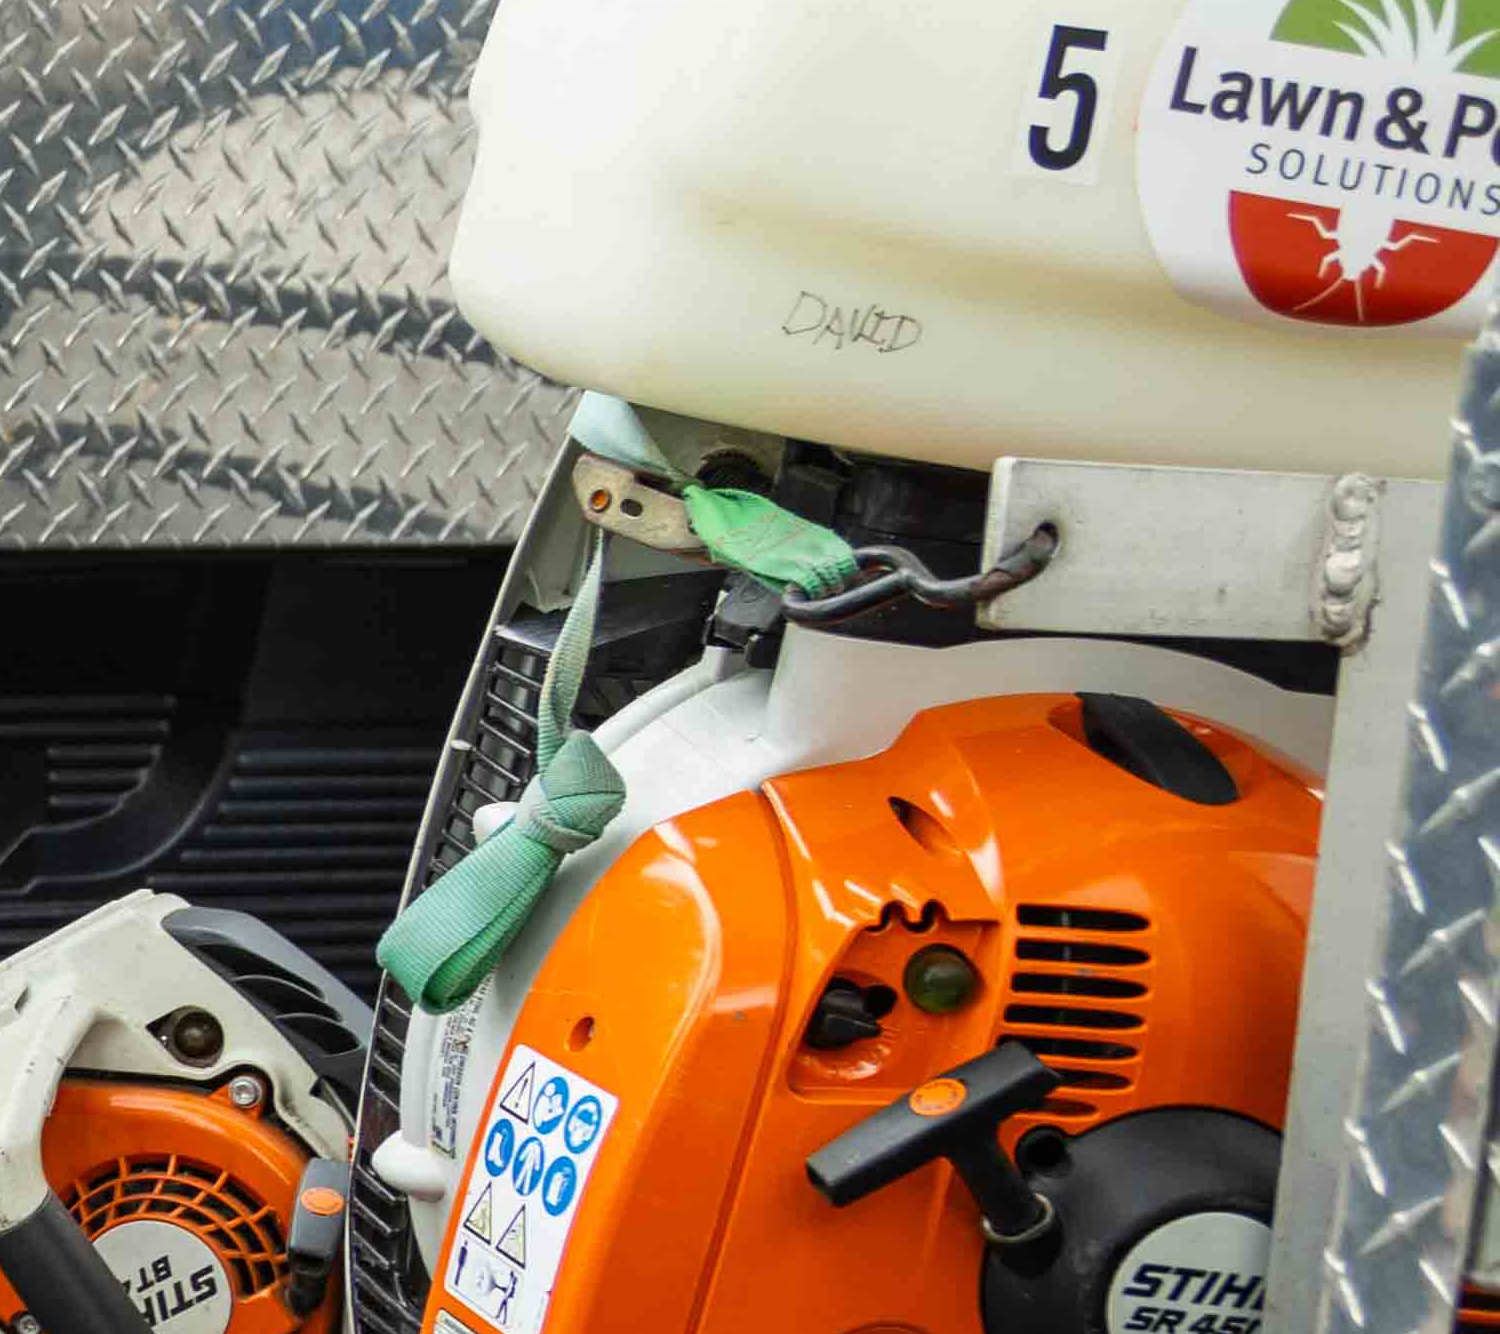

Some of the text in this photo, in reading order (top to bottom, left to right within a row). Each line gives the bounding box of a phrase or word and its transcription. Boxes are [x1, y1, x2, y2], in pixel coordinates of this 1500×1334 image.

[1028, 24, 1108, 170] 5
[1169, 46, 1364, 141] Lawn
[1374, 87, 1430, 155] &
[1245, 142, 1500, 216] SOLUTIONS
[123, 1255, 172, 1294] BT
[1124, 1306, 1187, 1334] SR
